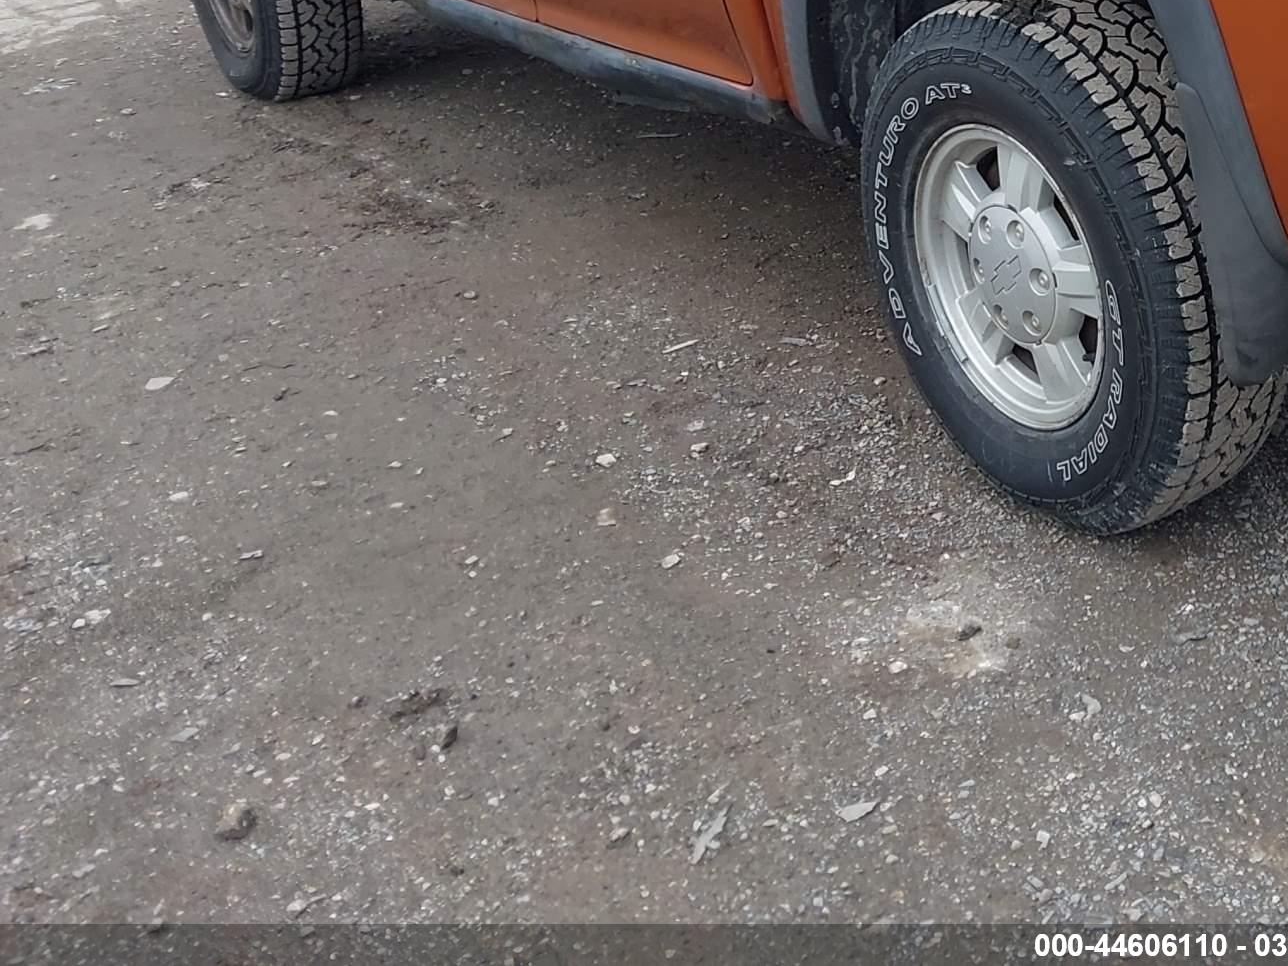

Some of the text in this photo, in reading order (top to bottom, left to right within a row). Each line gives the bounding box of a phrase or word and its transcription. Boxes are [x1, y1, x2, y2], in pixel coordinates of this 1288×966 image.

[875, 98, 922, 356] ADVENTURO
[1057, 280, 1125, 481] GT RADIAL
